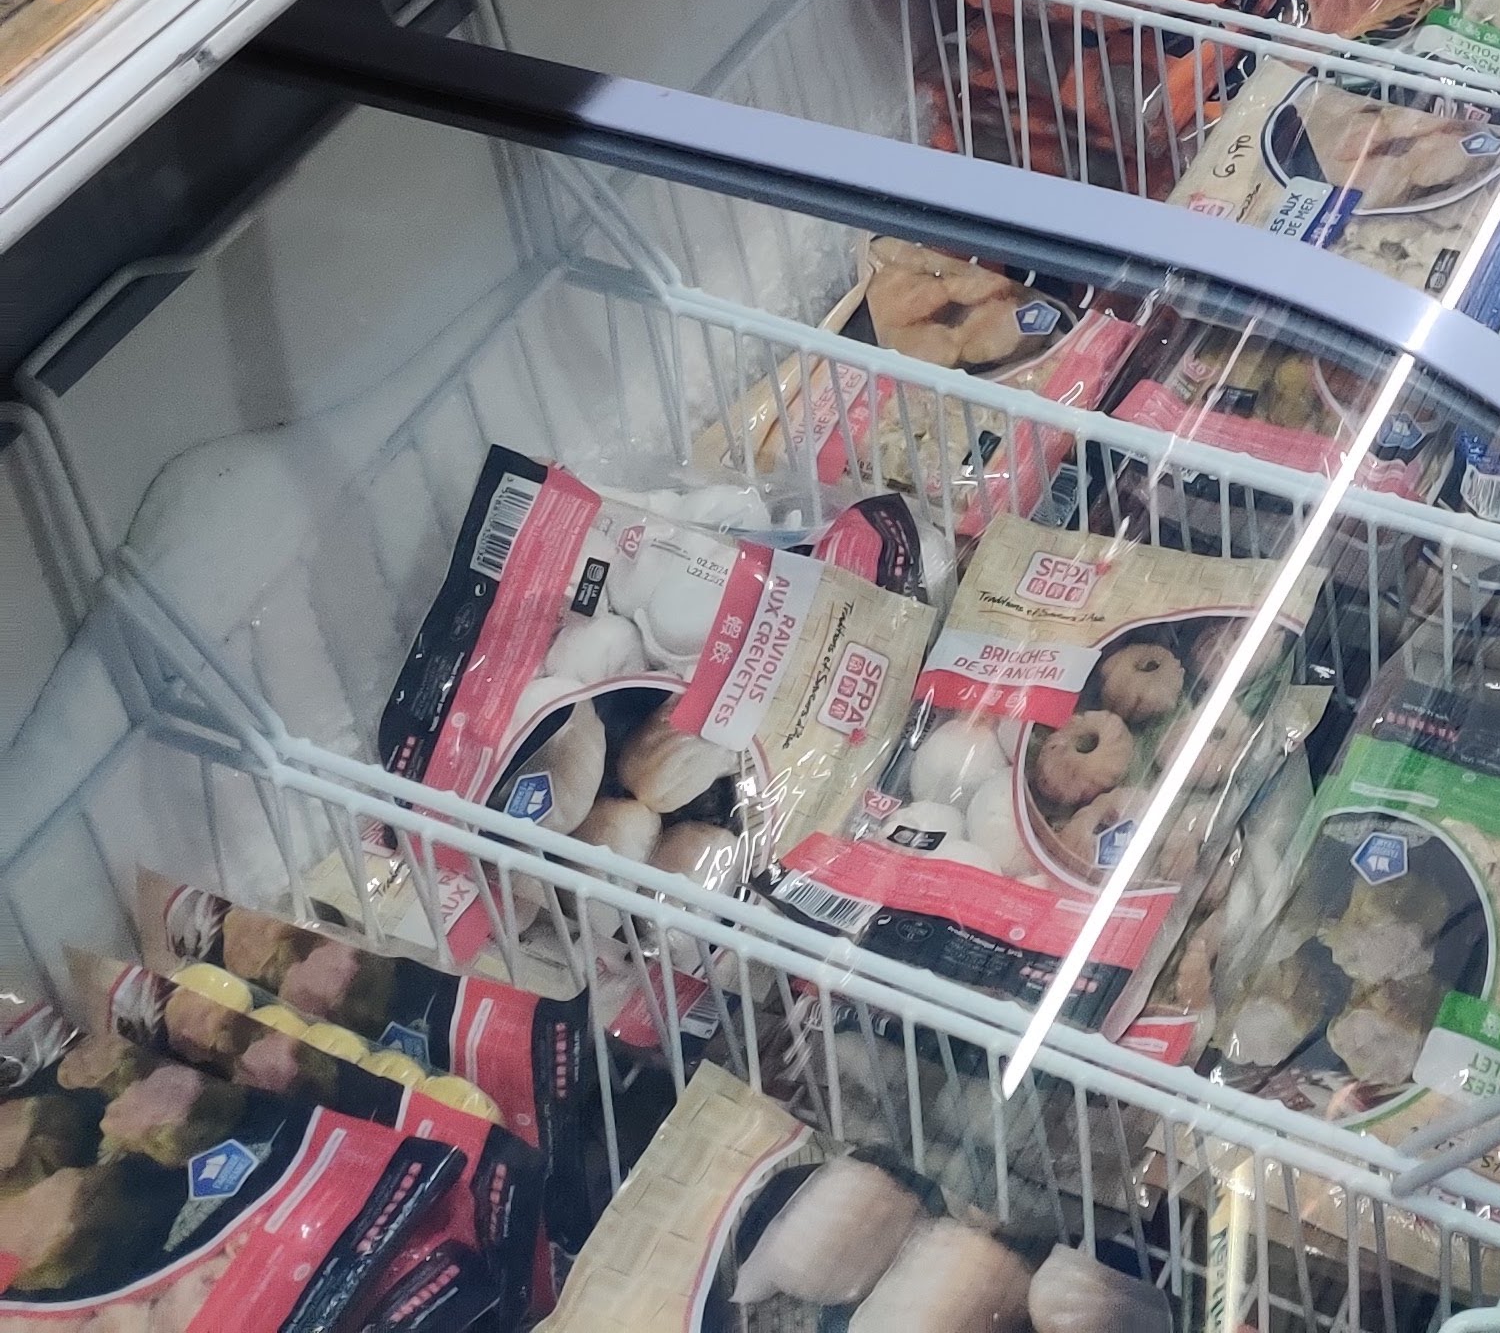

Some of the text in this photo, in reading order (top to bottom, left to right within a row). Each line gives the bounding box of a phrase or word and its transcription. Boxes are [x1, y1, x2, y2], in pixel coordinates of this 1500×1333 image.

[1279, 192, 1303, 217] AUX
[1284, 196, 1320, 237] DE MER
[1035, 557, 1092, 586] SFPA
[714, 575, 791, 728] AUX CREVETTES
[749, 613, 797, 704] RAVIOLIS
[953, 656, 980, 672] DE
[846, 660, 884, 726] SFPA
[868, 794, 896, 814] 20
